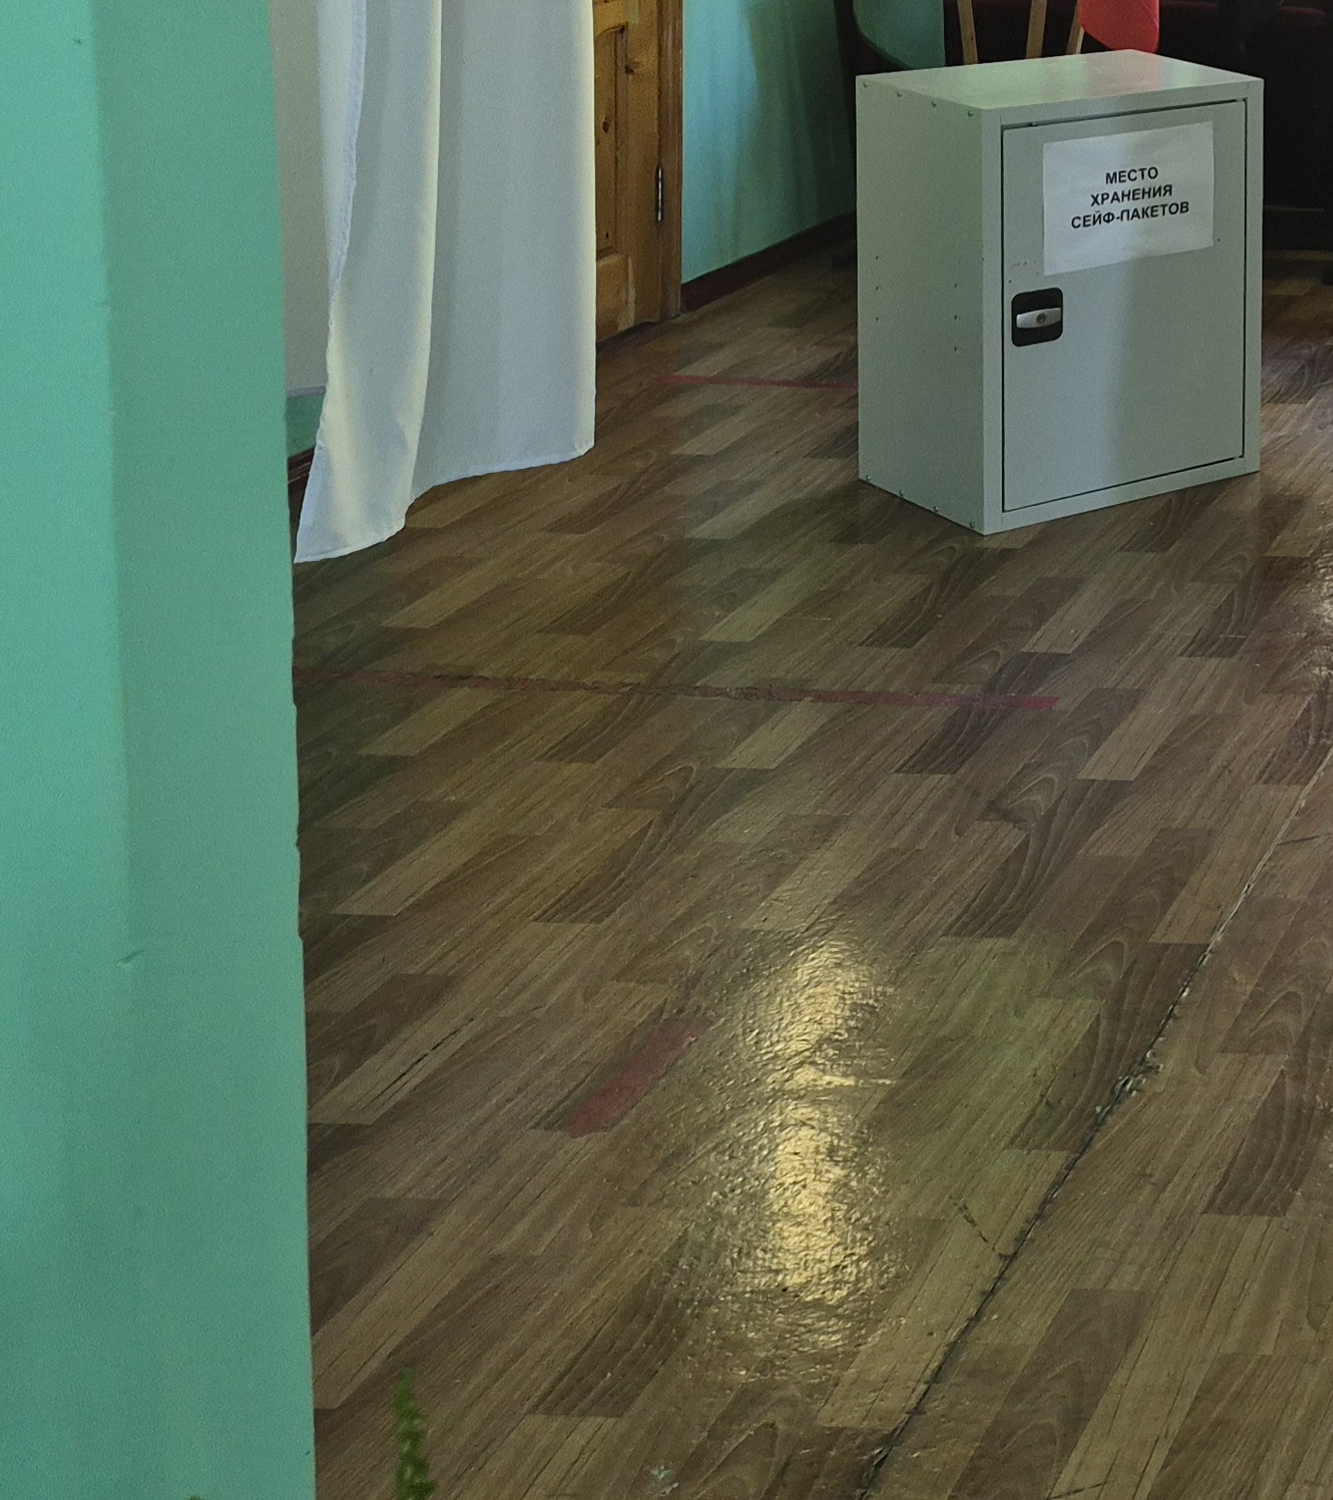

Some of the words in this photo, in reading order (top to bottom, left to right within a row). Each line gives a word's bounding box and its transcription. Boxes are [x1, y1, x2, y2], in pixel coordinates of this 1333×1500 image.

[1105, 166, 1159, 185] МЕСТО
[1090, 184, 1173, 207] ХРАНЕНИЯ
[1071, 201, 1190, 229] СЕЙФ-ПАКЕТОВ
